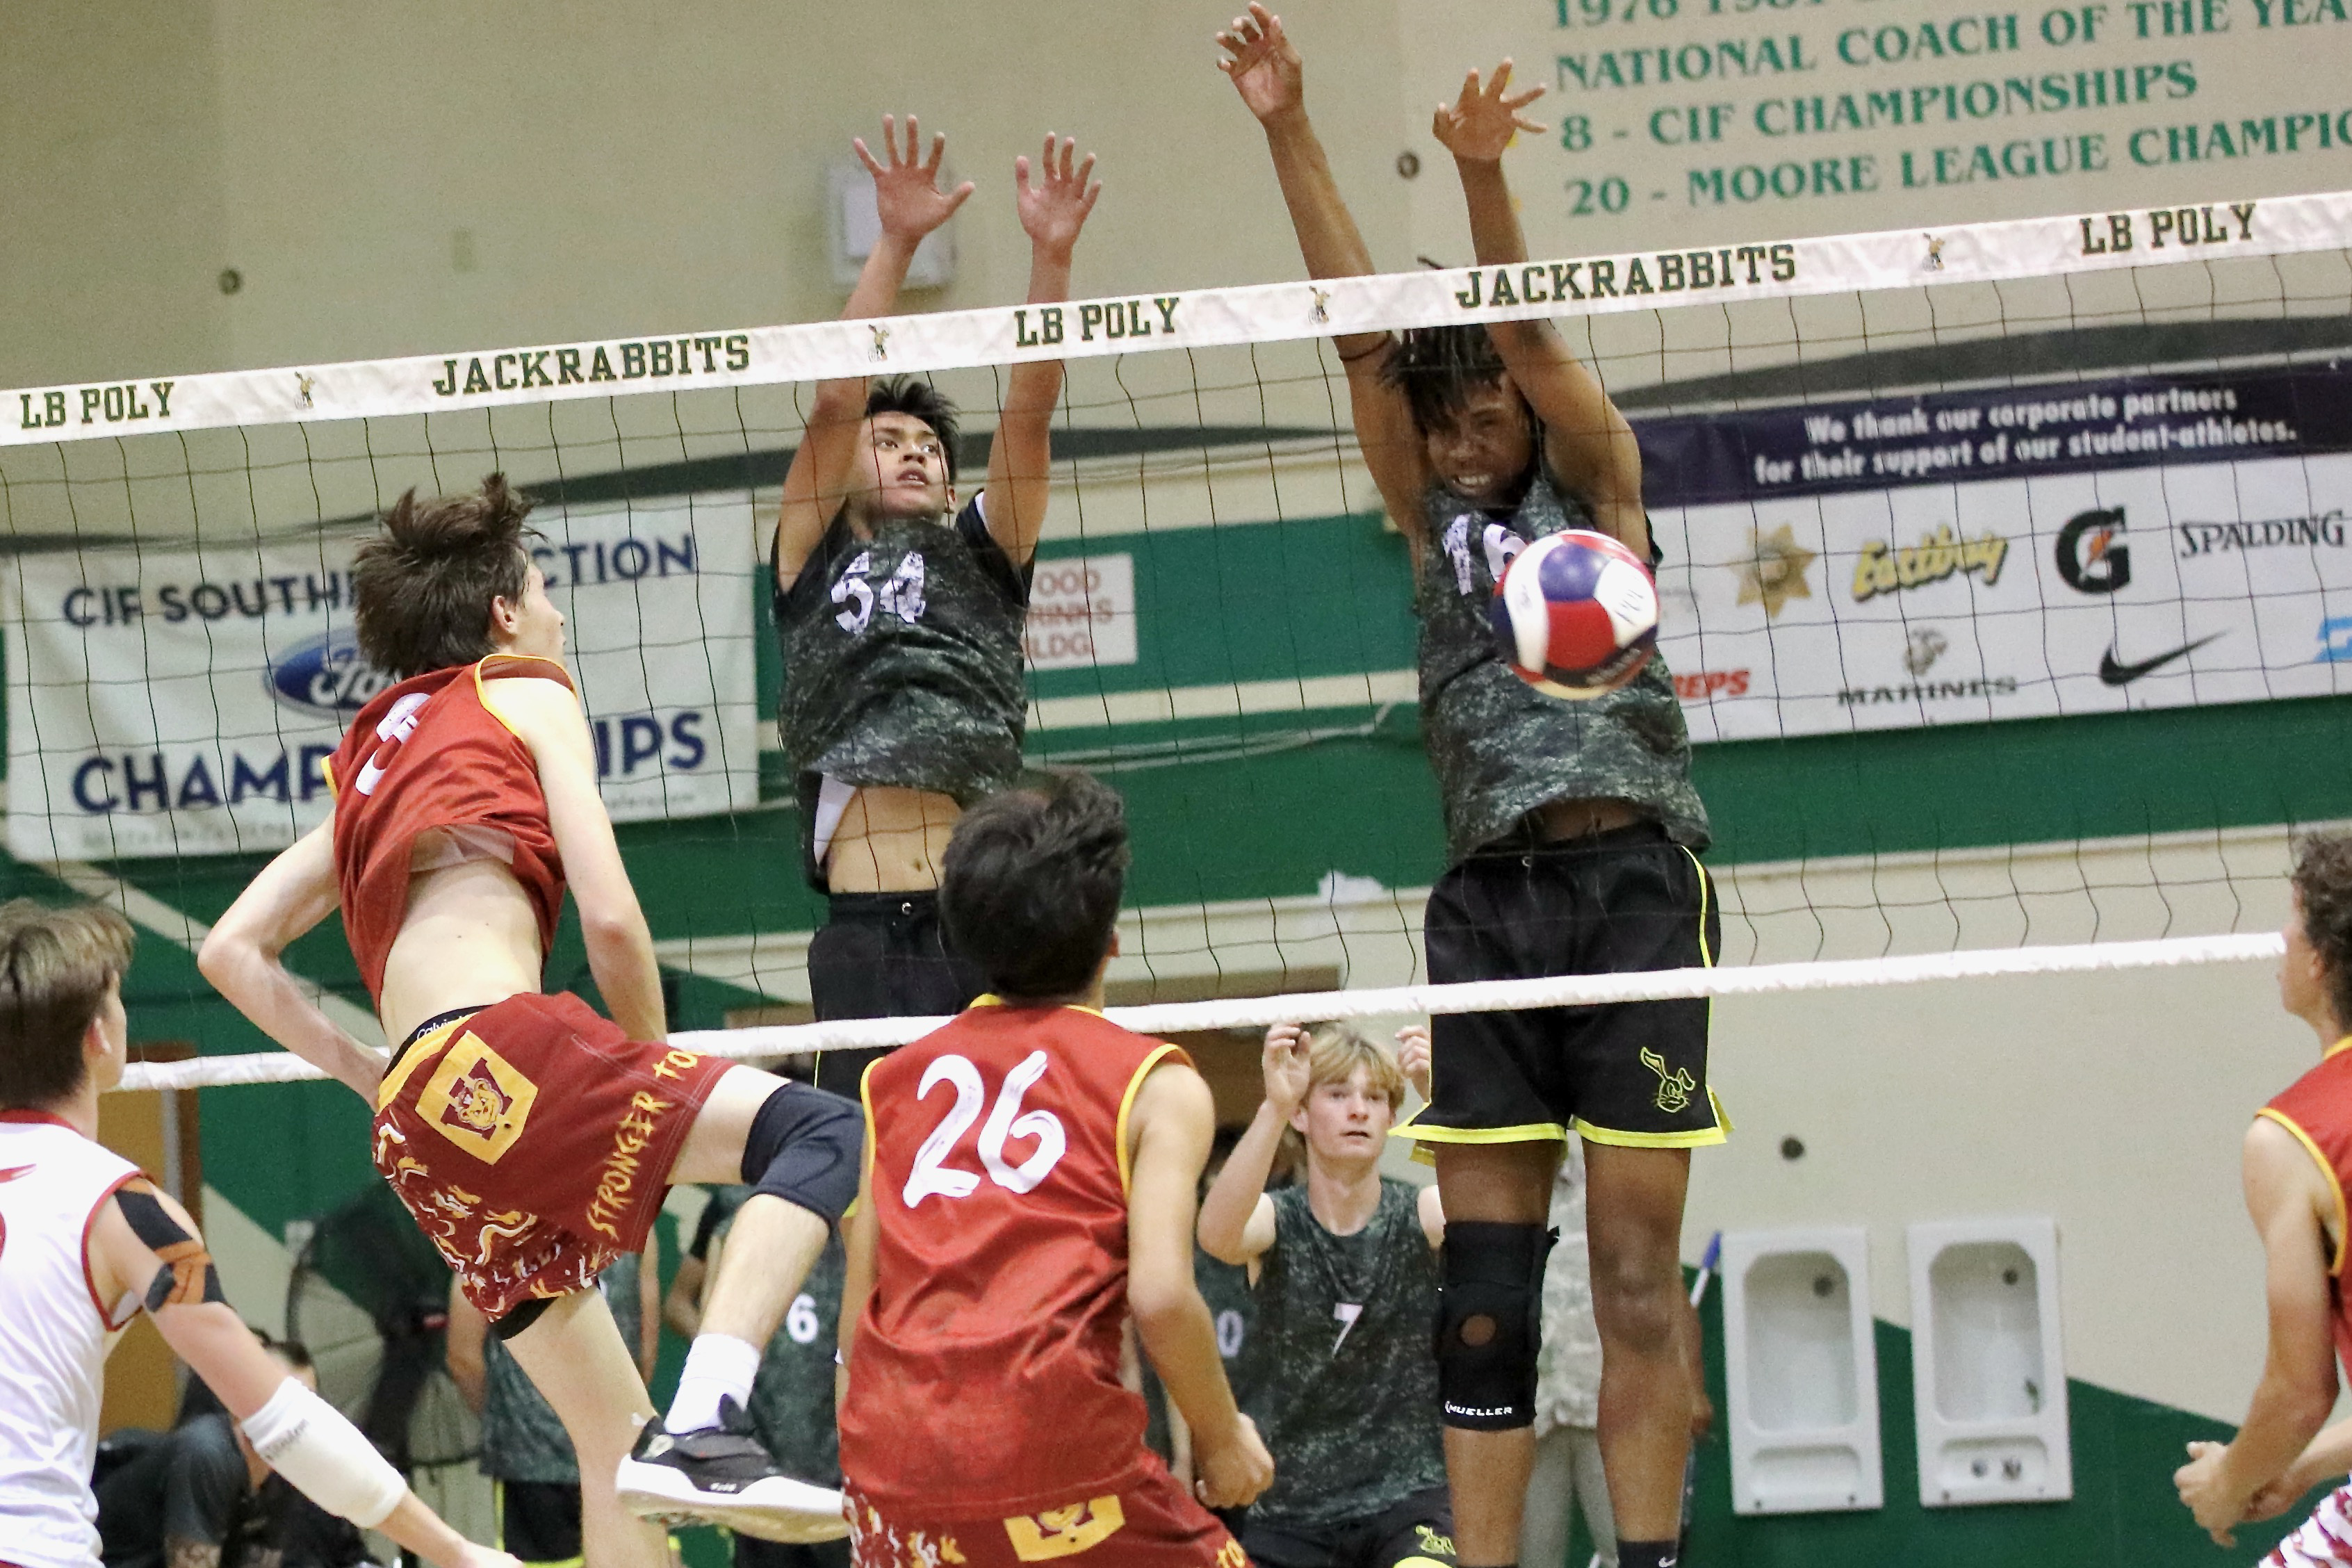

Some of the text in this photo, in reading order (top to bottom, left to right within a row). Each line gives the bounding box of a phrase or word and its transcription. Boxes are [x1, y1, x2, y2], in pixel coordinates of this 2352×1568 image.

[1556, 35, 1817, 91] NATIONAL
[1838, 14, 2020, 66] COACH
[2040, 3, 2107, 46] OF
[2127, 0, 2230, 38] THE
[1561, 115, 1593, 152] 8
[1649, 104, 1734, 145] CIF
[1754, 61, 2198, 137] CHAMPIONSHIPS
[1565, 177, 1631, 216] 20
[1688, 155, 1879, 206] MOORE
[1901, 133, 2109, 188] LEAGUE
[2079, 204, 2257, 256] LB POLY
[1455, 244, 1796, 309] JACKRABBITS
[1014, 297, 1179, 348] LB POLY
[432, 334, 749, 397] JACKRABBITS
[19, 382, 174, 429] LB POLY
[1805, 387, 2237, 444] We thank our corporate partners
[1754, 454, 1795, 484] for
[1800, 447, 1866, 481] their
[1872, 439, 1973, 477] support
[1978, 432, 2008, 465] of
[2014, 434, 2060, 462] our
[2180, 508, 2345, 558] SPALDING
[63, 585, 141, 626] CIF
[158, 570, 357, 623] SOUTH
[831, 551, 926, 635] 54
[1837, 676, 2017, 705] MARINES
[903, 1050, 1066, 1209] 26
[587, 1091, 674, 1241] STRONGER
[786, 1293, 819, 1344] 6
[1334, 1302, 1363, 1358] 7
[1446, 1402, 1513, 1416] MUELLER
